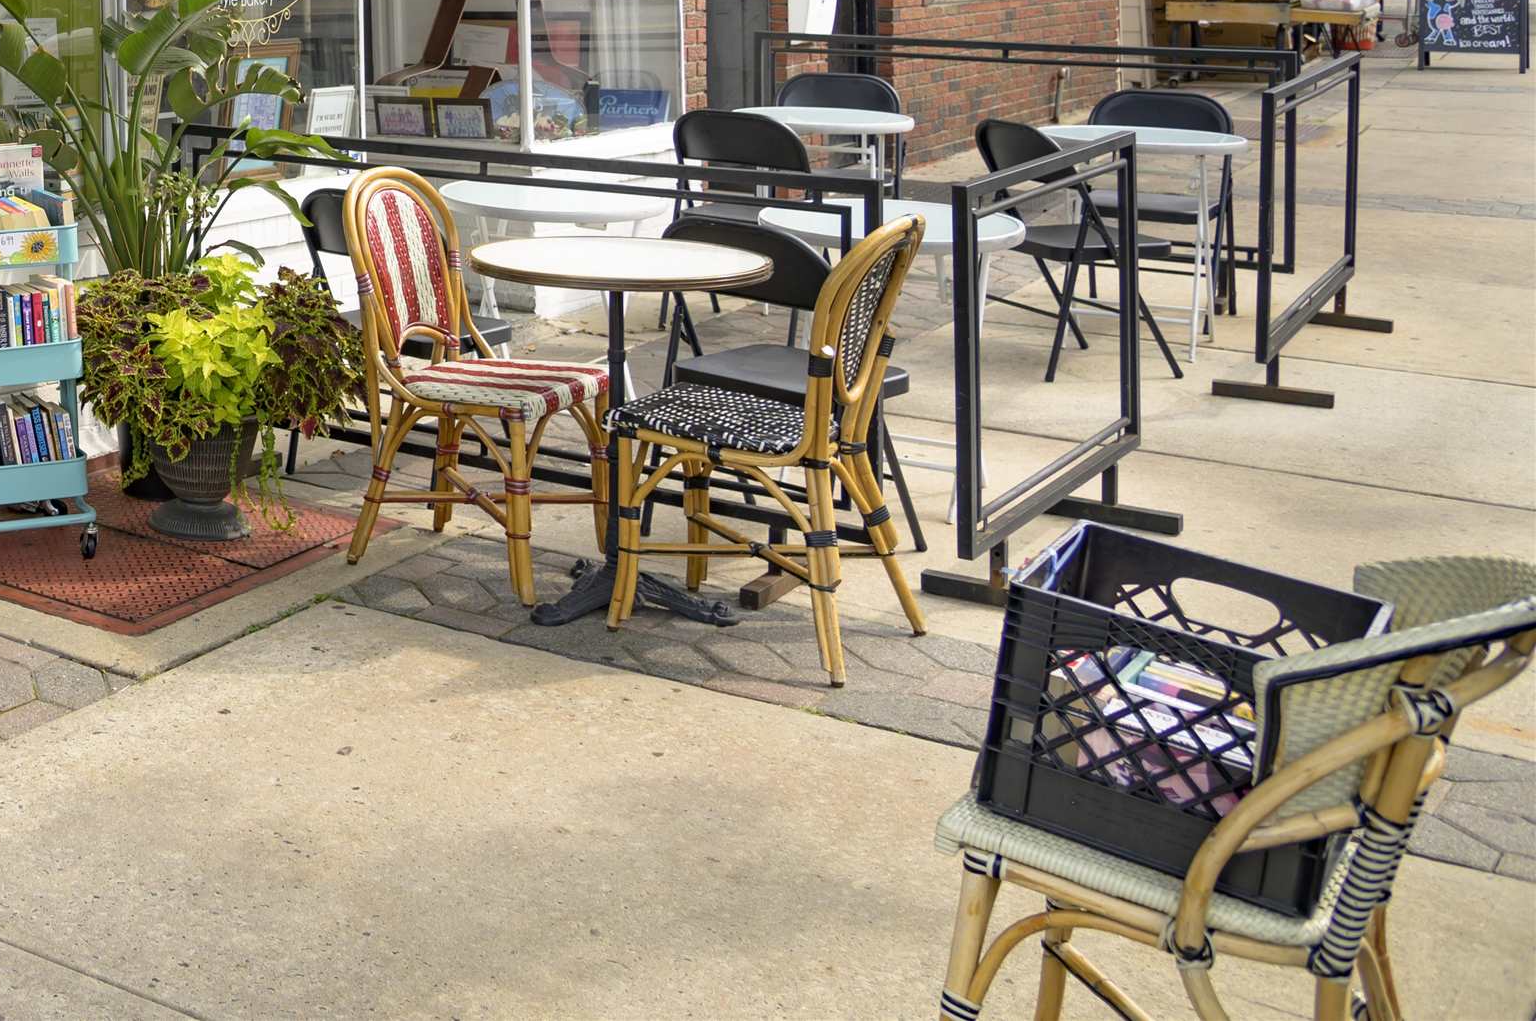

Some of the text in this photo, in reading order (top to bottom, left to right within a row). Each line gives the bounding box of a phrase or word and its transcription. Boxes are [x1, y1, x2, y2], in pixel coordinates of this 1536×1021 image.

[1471, 24, 1503, 38] BEST
[1472, 34, 1512, 49] cream!
[599, 94, 660, 116] Partners
[9, 169, 35, 179] Walls
